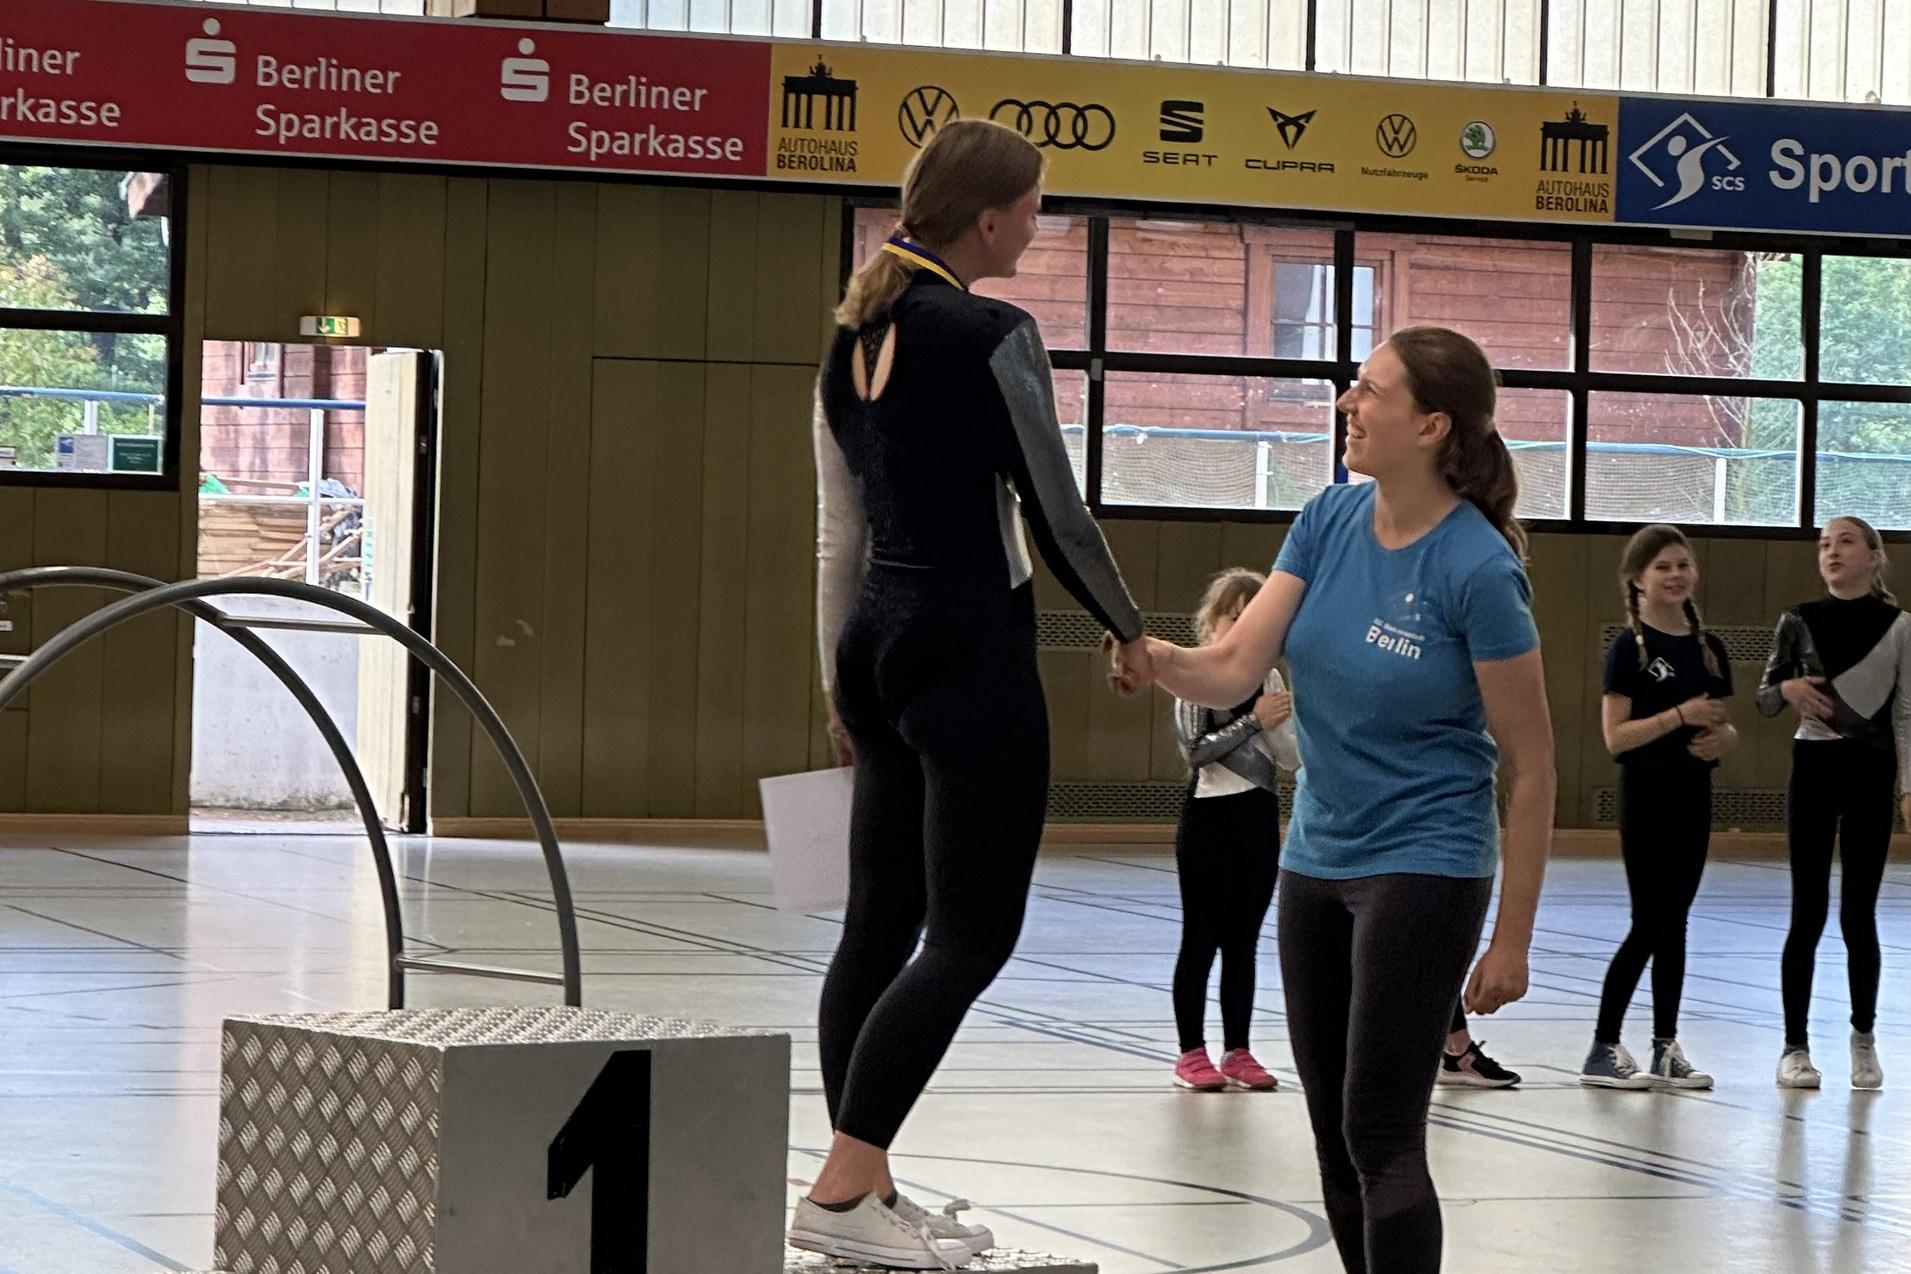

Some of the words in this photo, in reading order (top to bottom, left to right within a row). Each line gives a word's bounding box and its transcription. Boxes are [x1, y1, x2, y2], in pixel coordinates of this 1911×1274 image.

[257, 55, 402, 95] Berliner
[568, 74, 708, 112] Berliner
[256, 105, 440, 146] Sparkasse
[567, 121, 744, 162] Sparkasse
[778, 137, 858, 157] AUTOHAUS
[777, 154, 857, 172] BEROLINA
[1143, 151, 1218, 167] SEAT
[1245, 159, 1335, 173] CUPRA
[1361, 167, 1428, 181] Nutzfahrzeuge
[1712, 176, 1745, 191] SCS
[1536, 180, 1609, 198] AUTOHAUS
[1536, 196, 1608, 213] BEROLINA
[1365, 625, 1422, 660] Berlin
[548, 1049, 652, 1274] 1
